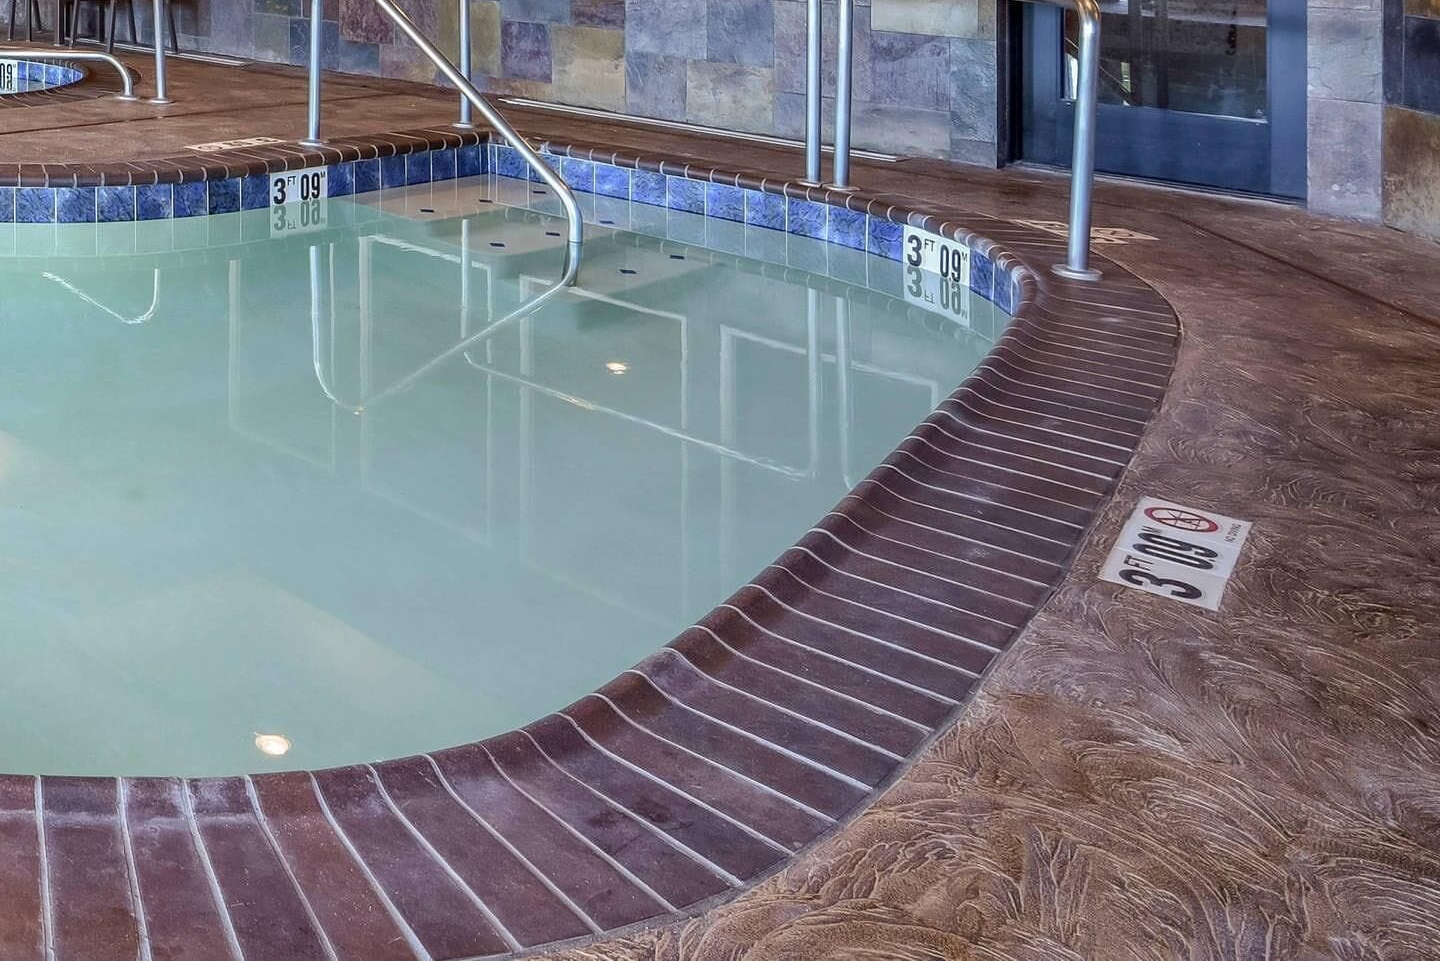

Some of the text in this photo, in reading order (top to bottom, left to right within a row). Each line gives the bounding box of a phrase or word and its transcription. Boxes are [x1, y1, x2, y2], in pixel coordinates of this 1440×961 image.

[274, 178, 286, 204] 3
[288, 176, 296, 186] FT
[907, 234, 922, 267] 3
[924, 238, 936, 252] FT
[1124, 554, 1154, 572] FT
[1118, 569, 1202, 600] 3
